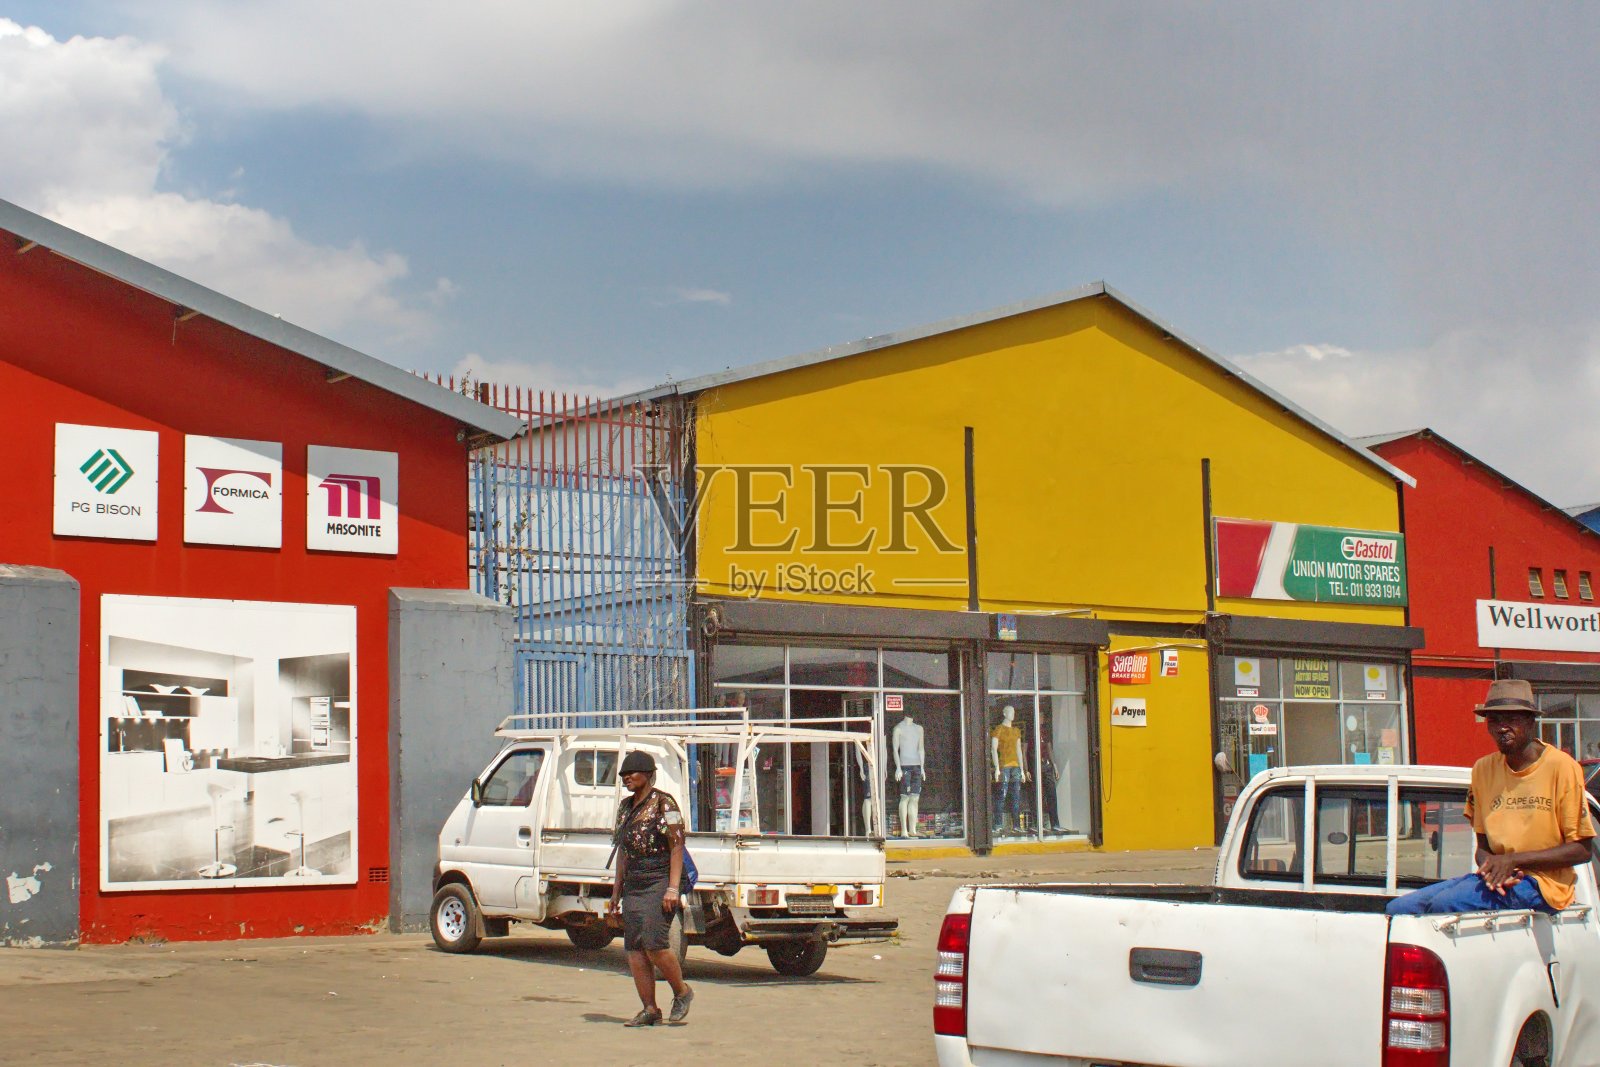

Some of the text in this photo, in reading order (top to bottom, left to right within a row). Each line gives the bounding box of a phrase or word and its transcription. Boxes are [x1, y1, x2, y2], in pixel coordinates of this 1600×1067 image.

[213, 486, 269, 500] FORMICA
[71, 501, 141, 516] PG BISON
[326, 522, 382, 538] MASONITE
[1355, 540, 1393, 560] Castrol
[1292, 560, 1400, 582] UNION MOTOR SPARES
[1329, 581, 1400, 598] TEL: 011 933 1914
[1488, 605, 1600, 632] Wellwort
[1295, 686, 1329, 697] NOW OPEN
[1121, 706, 1146, 718] Payen
[1506, 797, 1528, 806] CAPE
[1529, 796, 1552, 808] GATE
